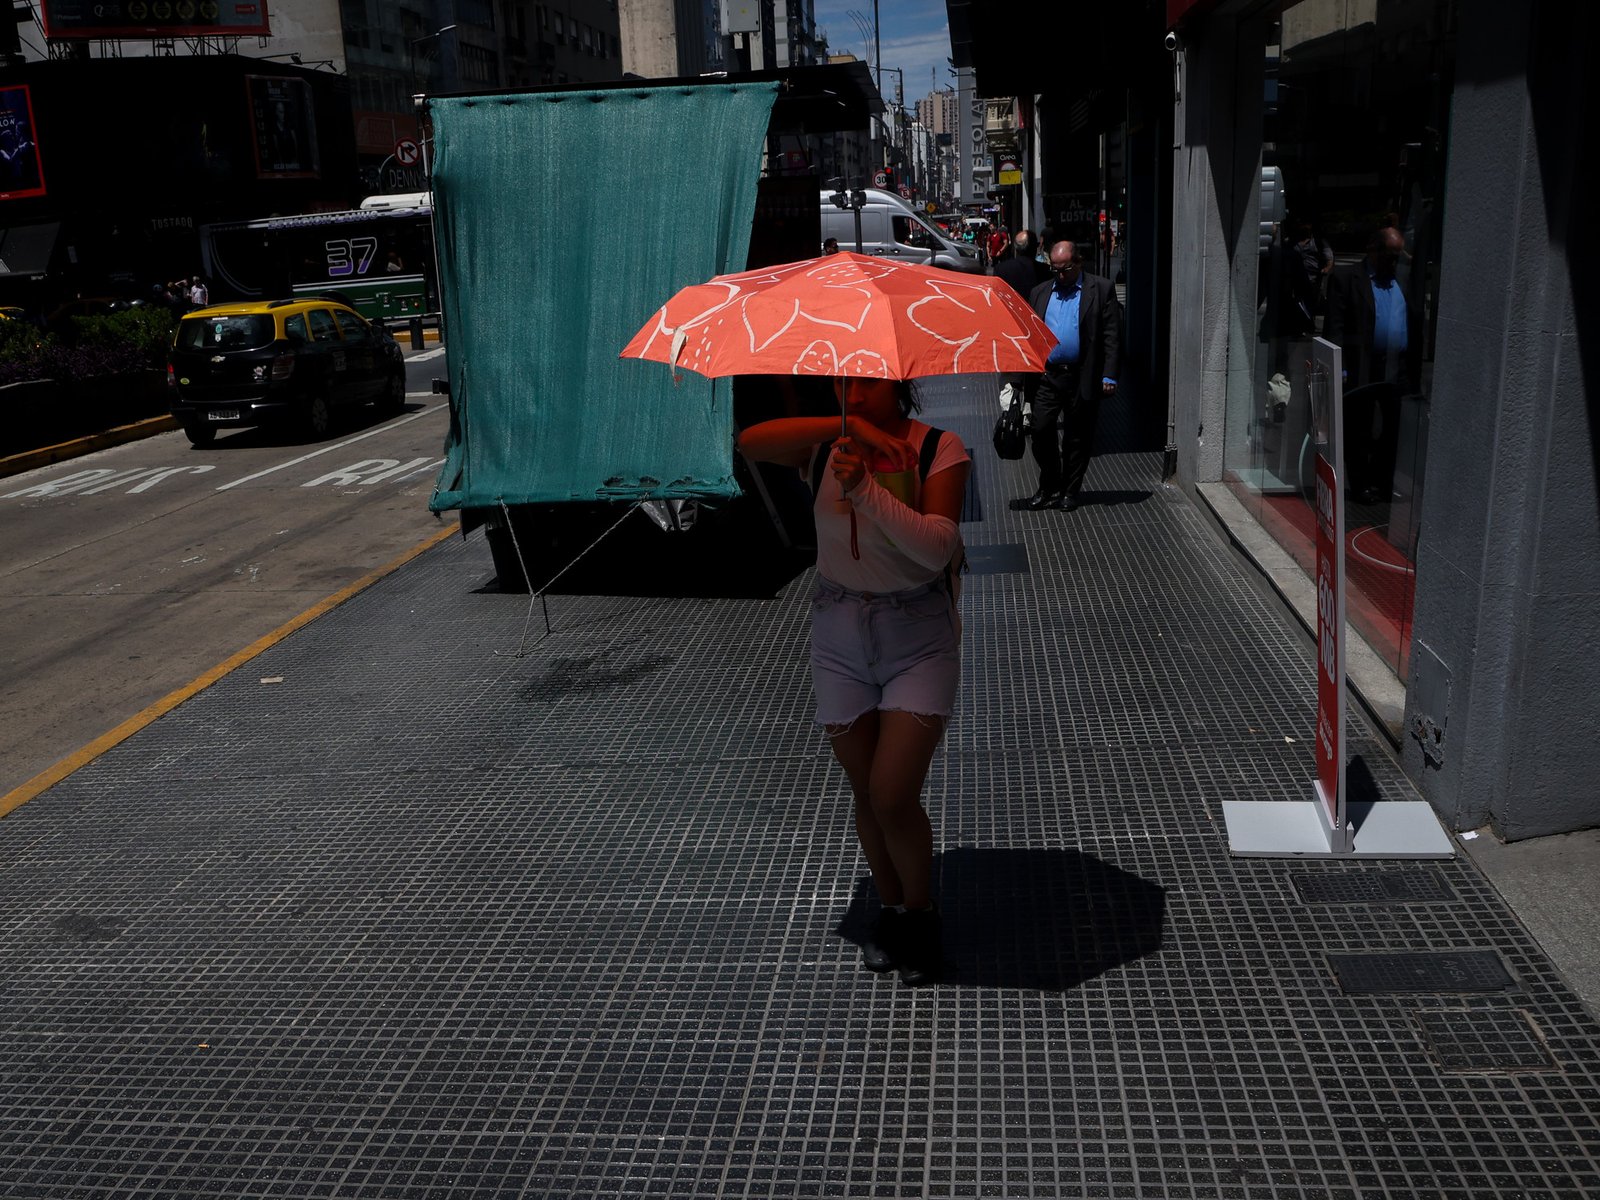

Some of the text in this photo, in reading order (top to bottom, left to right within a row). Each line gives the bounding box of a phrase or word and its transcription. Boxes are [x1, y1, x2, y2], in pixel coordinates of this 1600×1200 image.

[325, 236, 378, 277] 37
[1319, 573, 1336, 637] 600
[1321, 619, 1336, 685] MB
